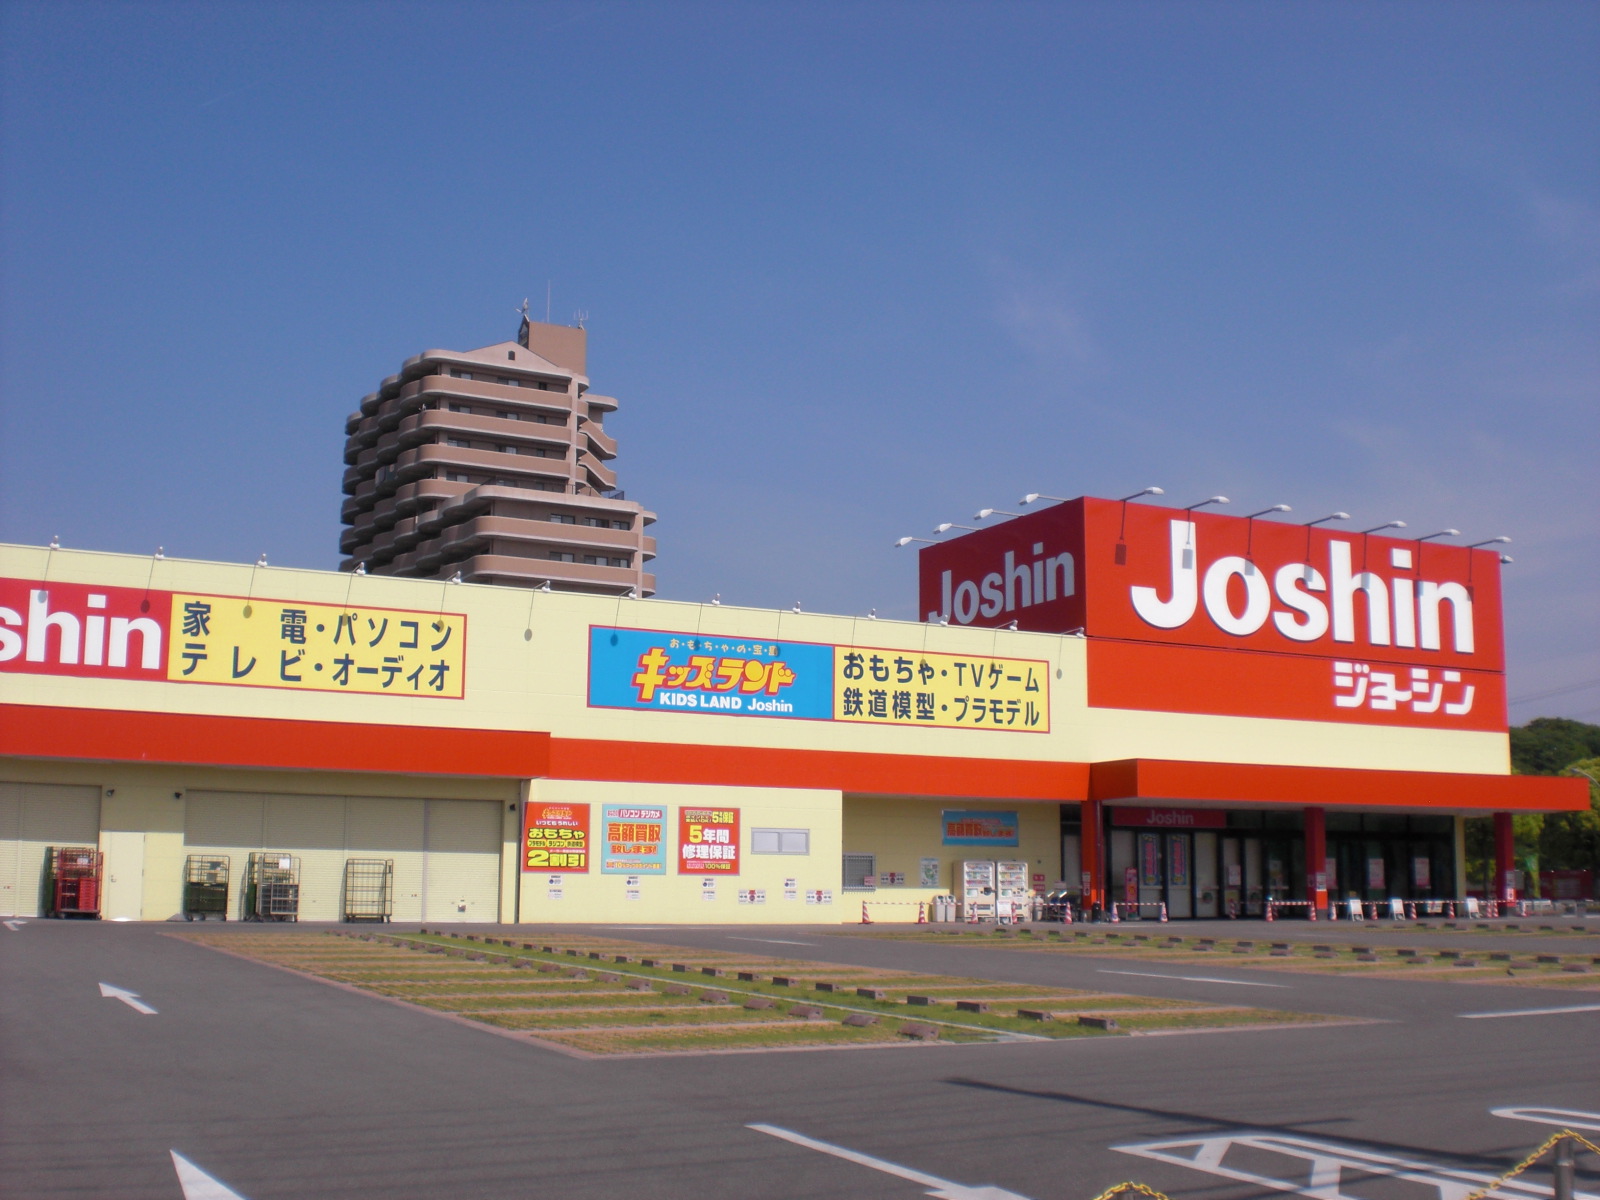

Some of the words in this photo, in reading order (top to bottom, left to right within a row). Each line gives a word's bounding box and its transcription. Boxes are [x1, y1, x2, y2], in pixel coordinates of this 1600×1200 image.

[928, 542, 1074, 624] Joshin
[1131, 519, 1474, 653] Joshin
[182, 643, 450, 691] テレビ・オーディオ
[631, 647, 796, 703] キッズランド
[843, 653, 1039, 693] おもちゃ・TVゲーム
[660, 692, 698, 707] KIDS
[700, 694, 742, 709] LAND
[747, 698, 793, 712] Joshin
[1335, 661, 1475, 715] ジョーシン
[843, 687, 1040, 726] 鉄道模型・プラモデル
[1146, 810, 1194, 825] Joshin
[528, 828, 585, 840] おもちゃ
[607, 823, 661, 842] 高額買取
[689, 825, 730, 843] 5年間
[527, 849, 585, 867] 2割引
[682, 844, 736, 859] 修理保証
